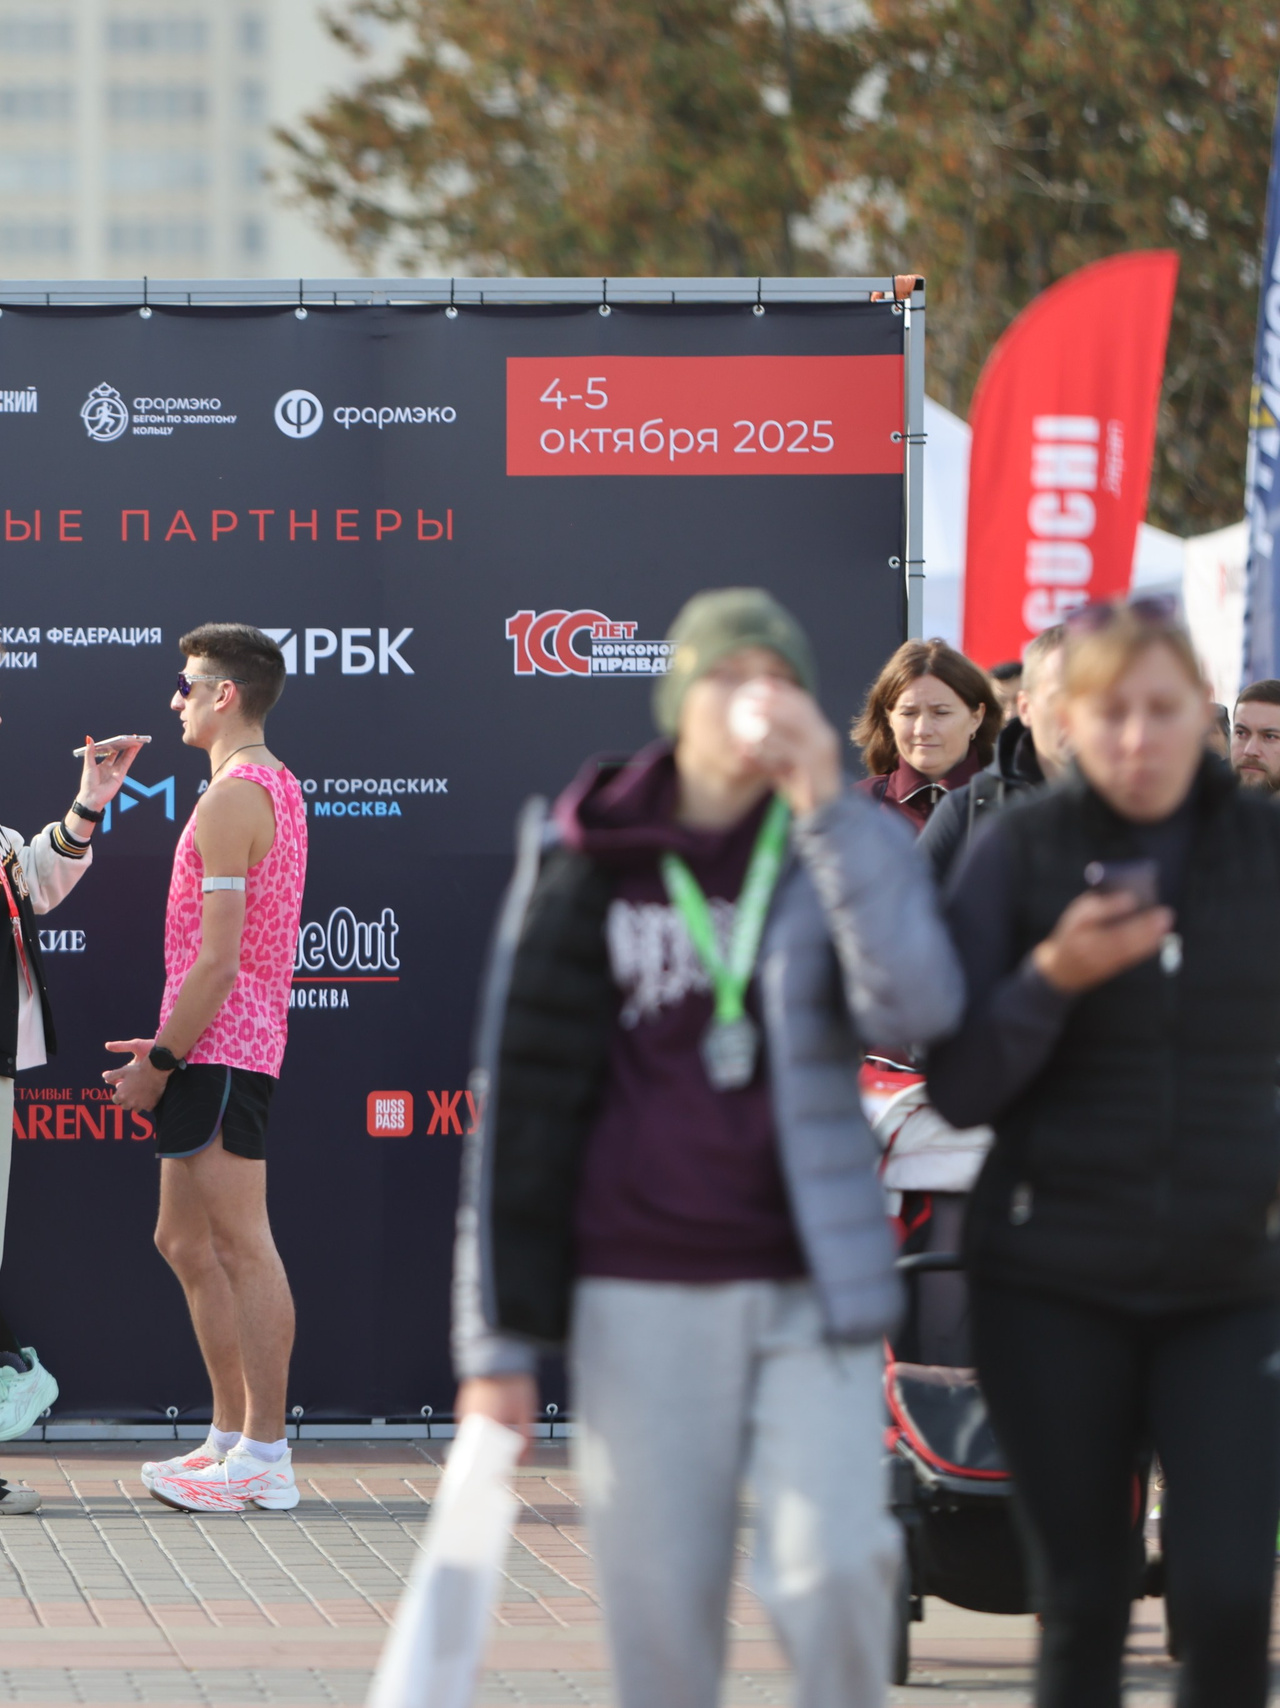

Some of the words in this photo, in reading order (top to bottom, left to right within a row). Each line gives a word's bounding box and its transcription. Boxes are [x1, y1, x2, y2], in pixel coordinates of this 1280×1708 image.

[539, 376, 608, 411] 4-5
[133, 415, 165, 424] БЕГОМ
[167, 415, 182, 424] ПО
[183, 414, 237, 424] ЗОЛОТОМУ
[333, 403, 457, 430] фармэко
[133, 426, 173, 436] КОЛЬЦУ
[539, 418, 718, 461] октября
[732, 420, 835, 454] 2025
[122, 508, 454, 542] ПАРТНЕРЫ
[1022, 414, 1101, 640] GUCHI
[46, 627, 162, 646] ФЕДЕРАЦИЯ
[590, 621, 638, 640] ЛЕТ
[305, 627, 414, 675] РБК
[324, 778, 448, 796] ГОРОДСКИХ
[314, 801, 402, 817] МОСКВА
[375, 1098, 405, 1114] RUSS
[375, 1114, 405, 1130] PASS
